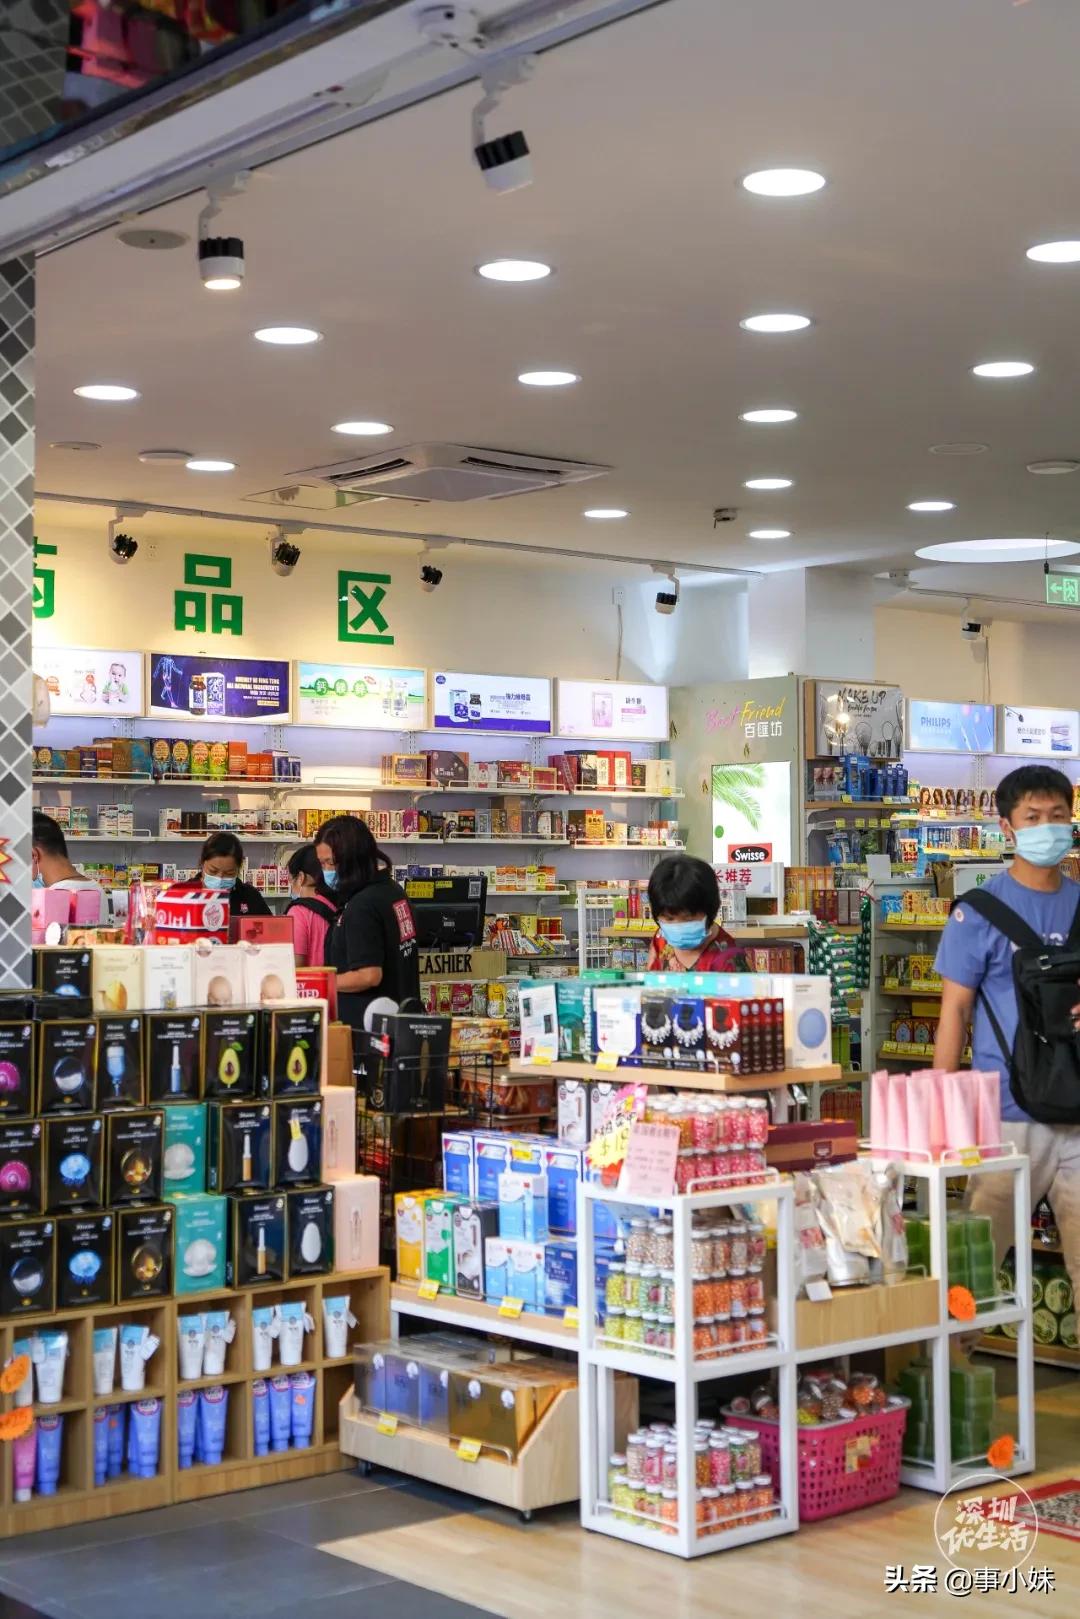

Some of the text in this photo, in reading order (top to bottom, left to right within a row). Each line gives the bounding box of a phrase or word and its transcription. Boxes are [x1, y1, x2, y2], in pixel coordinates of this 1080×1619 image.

[740, 697, 787, 727] Friend
[920, 716, 951, 729] PHILIPS
[735, 848, 765, 861] Swisse
